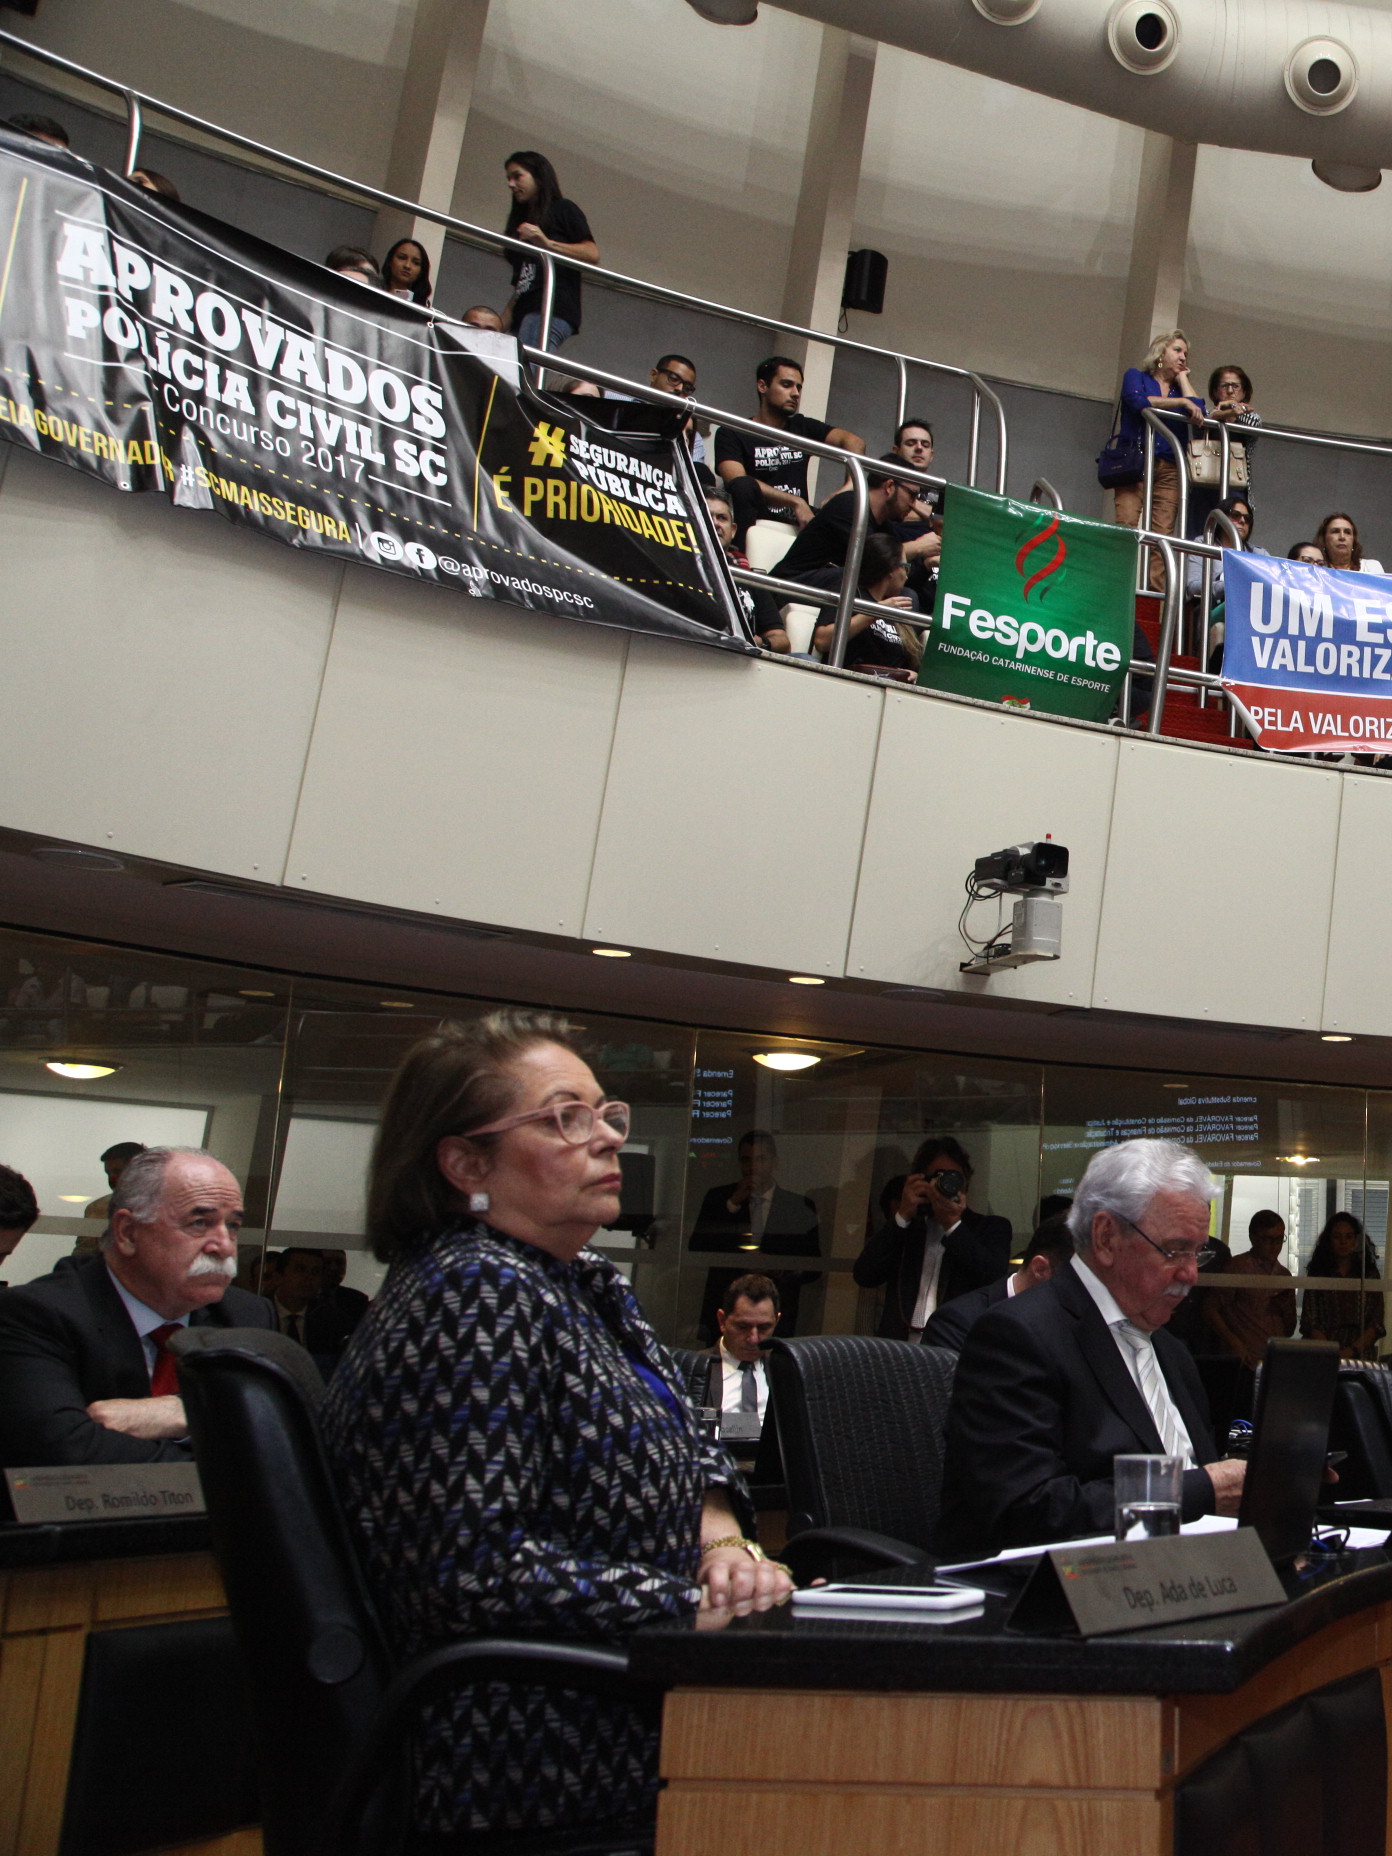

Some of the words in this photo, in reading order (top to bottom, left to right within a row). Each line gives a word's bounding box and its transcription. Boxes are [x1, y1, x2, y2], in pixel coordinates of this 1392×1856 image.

[57, 222, 446, 439] APROVADOS
[64, 296, 255, 416] POLÍCIA
[266, 390, 385, 466] CIVIL
[393, 438, 448, 487] SC
[0, 395, 175, 482] EIAGOVERNADR
[163, 383, 291, 458] Concurso
[301, 439, 366, 484] 2017
[569, 434, 677, 491] SEGURANÇA
[180, 463, 352, 545] #SCMAISSEGURA
[493, 466, 513, 514] É
[523, 477, 701, 554] PRIORIDADE!
[437, 556, 595, 609] @aprovadospcsc
[1250, 582, 1334, 639] UM
[942, 592, 1121, 671] Fesporte
[938, 642, 990, 662] FUNDAÇÃO
[991, 656, 1055, 680] CATARINENSE
[1057, 672, 1069, 684] DE
[1070, 676, 1111, 693] ESPORTE
[1250, 705, 1304, 734] PELA
[65, 1495, 98, 1512] Dep.
[102, 1491, 157, 1509] Romildo
[159, 1490, 194, 1505] Titon
[1123, 1586, 1157, 1611] Dep.
[1159, 1580, 1188, 1604] Ada
[1189, 1576, 1207, 1598] de
[1207, 1575, 1238, 1597] Luca
